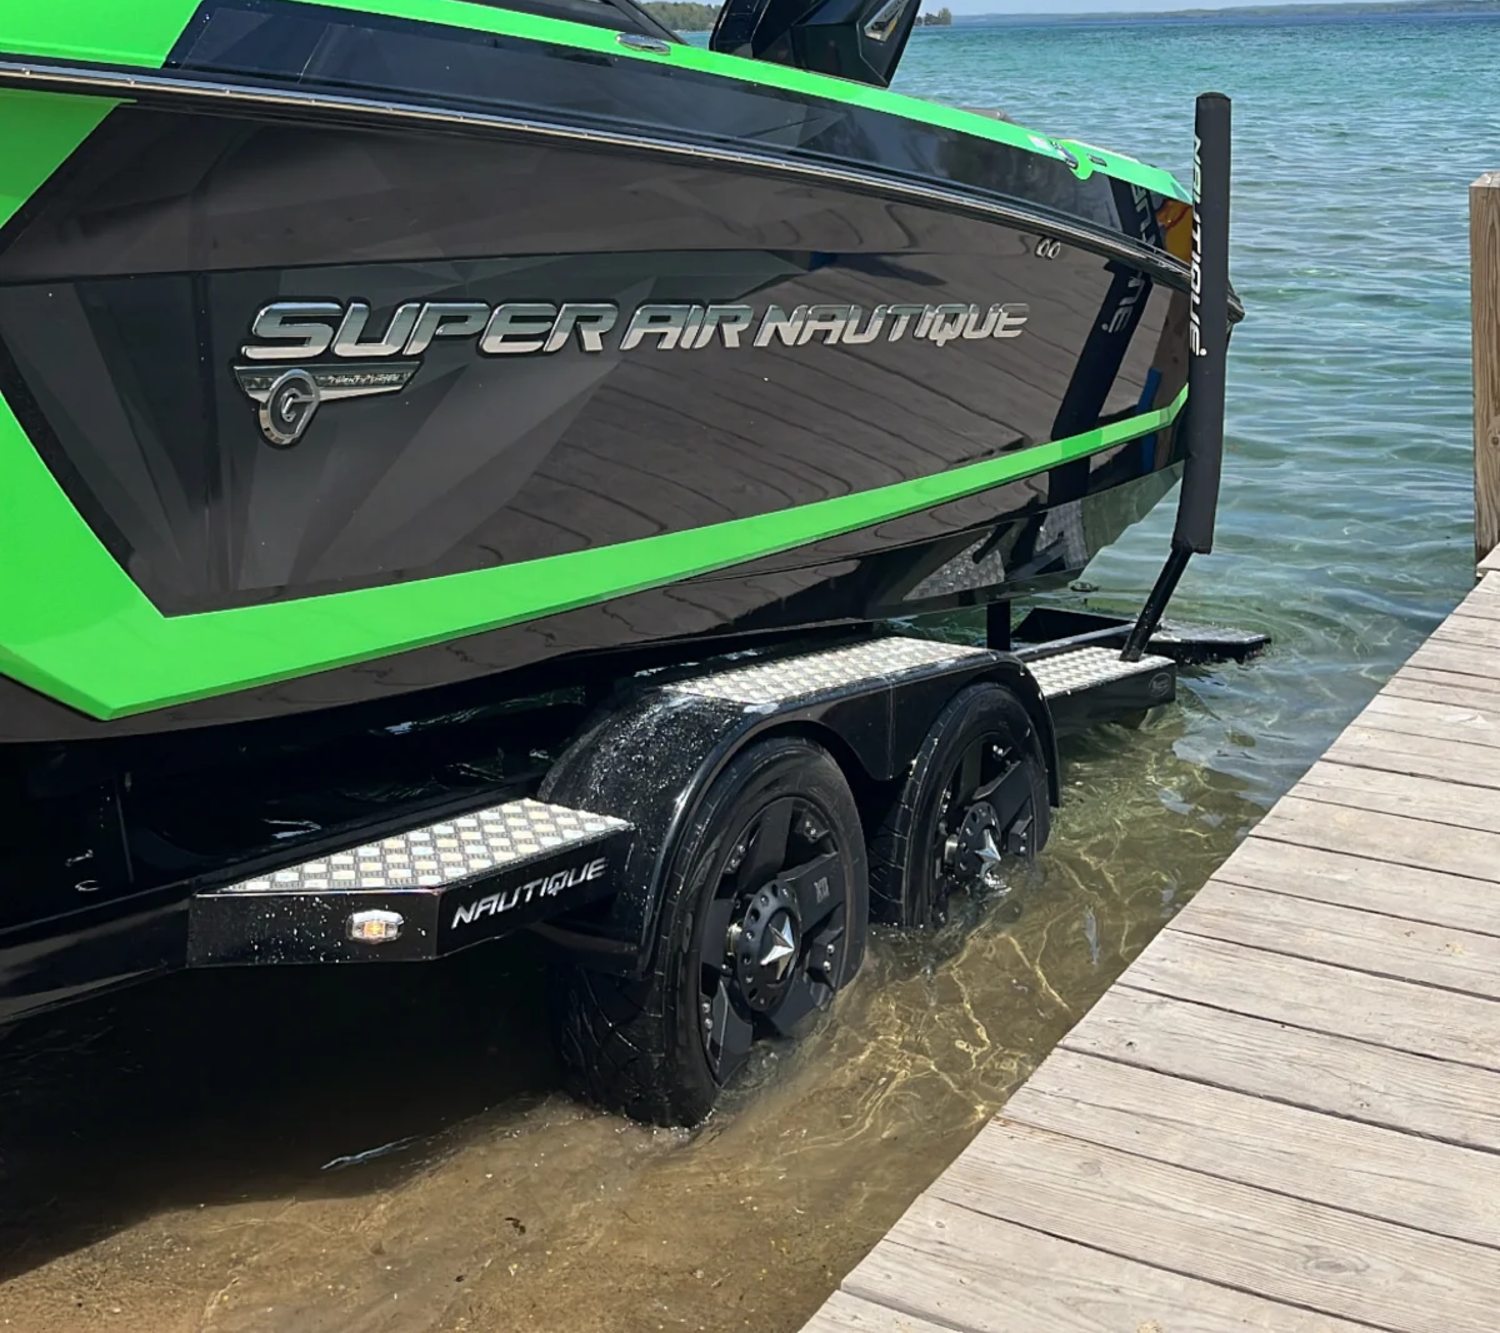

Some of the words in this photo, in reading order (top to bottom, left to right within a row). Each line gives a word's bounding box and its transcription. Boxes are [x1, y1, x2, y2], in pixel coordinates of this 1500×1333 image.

[241, 300, 619, 359] SUPER
[619, 303, 753, 350] AIR
[753, 302, 1030, 348] NAUTIQUE
[451, 856, 606, 929] NAUTIQUE
